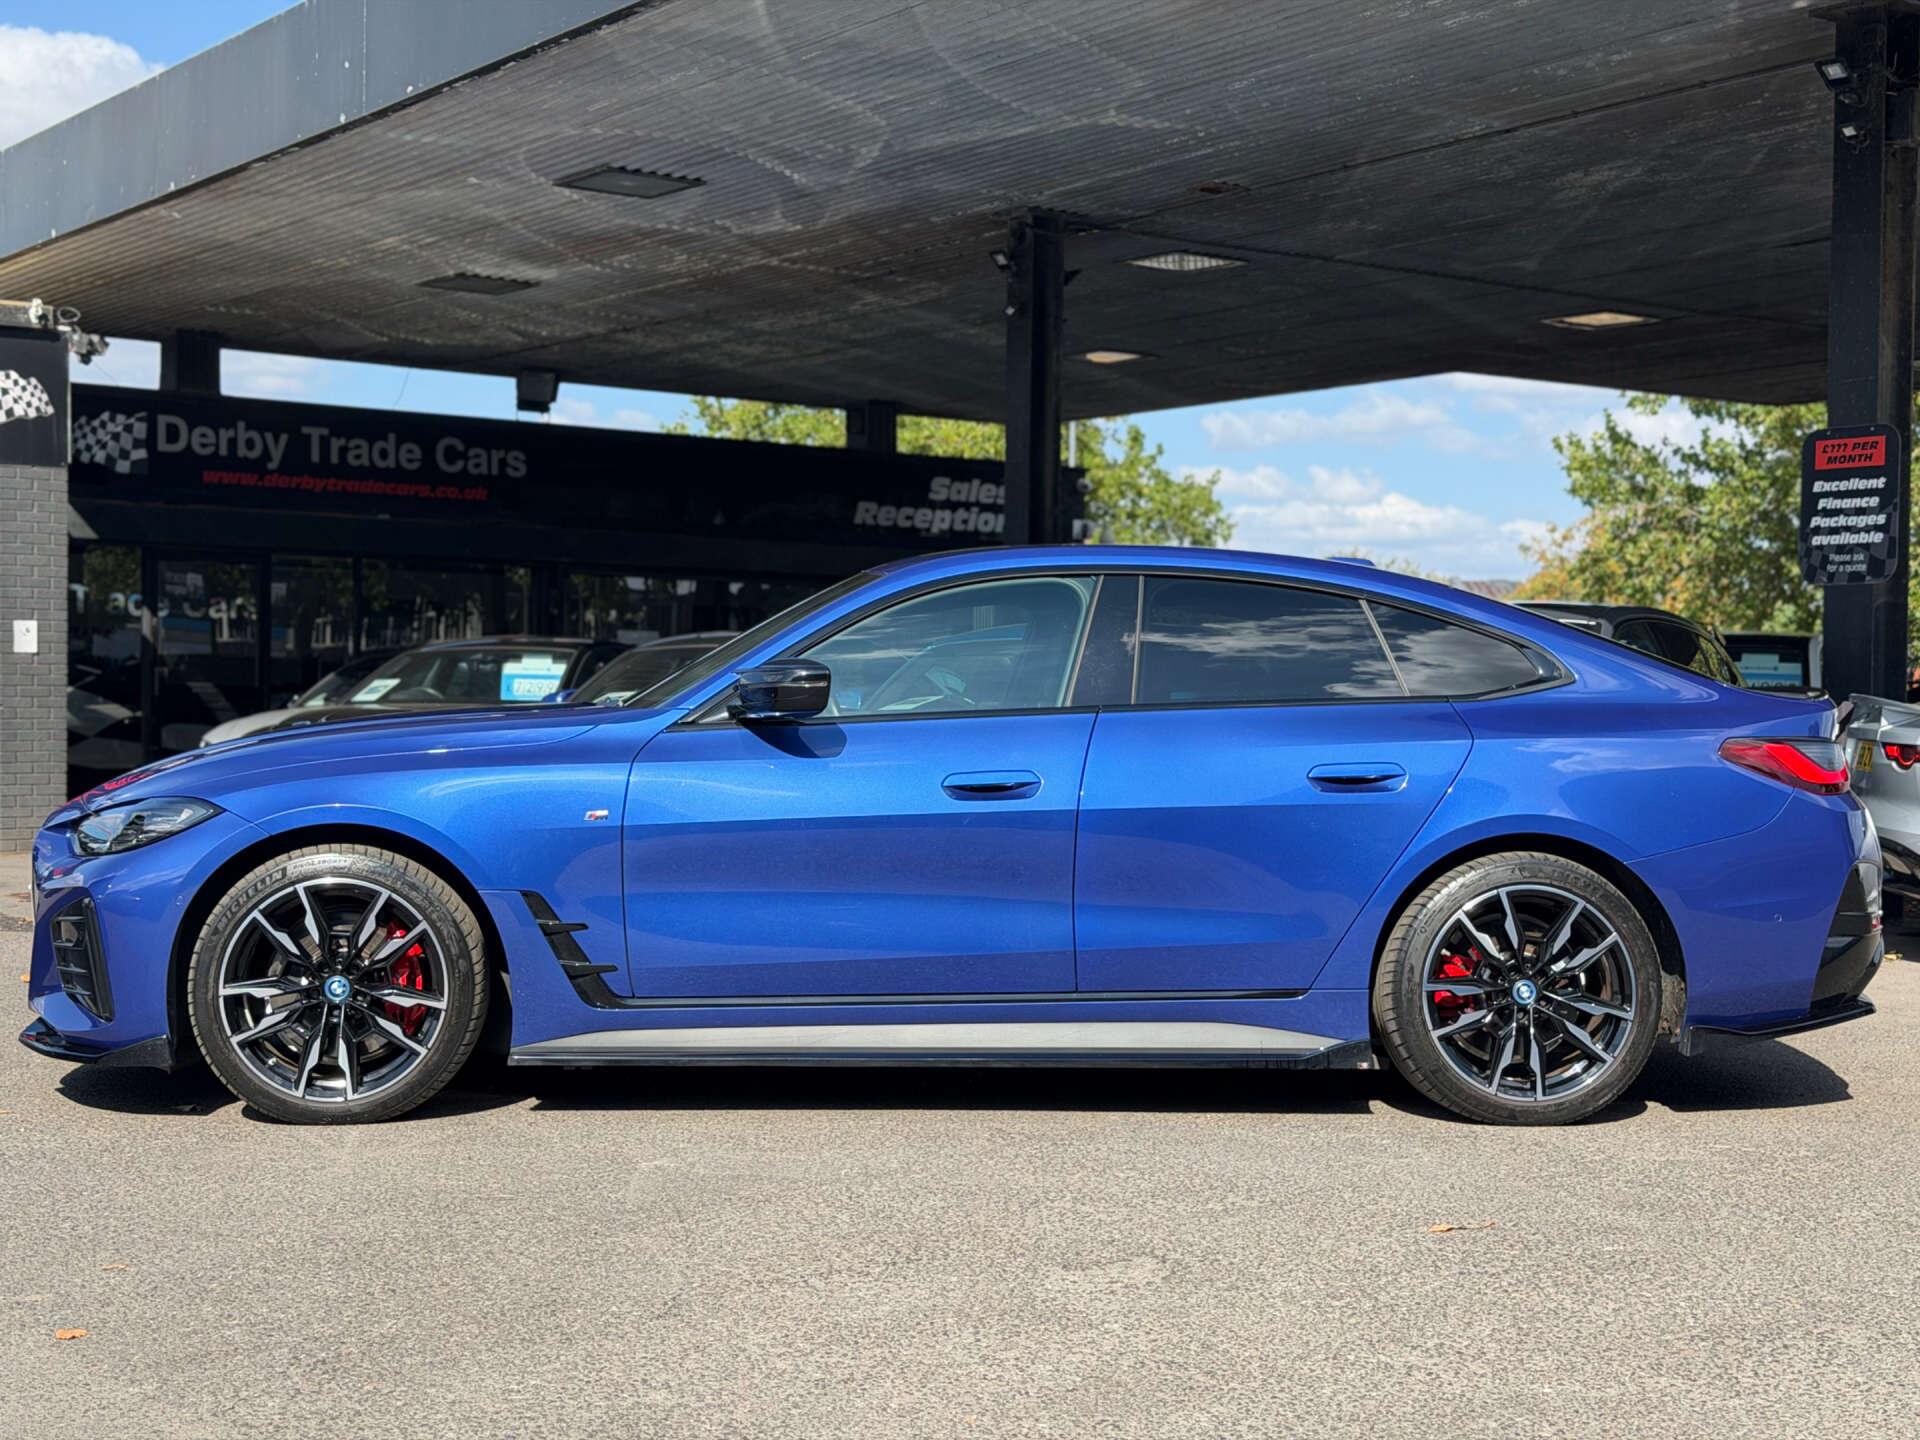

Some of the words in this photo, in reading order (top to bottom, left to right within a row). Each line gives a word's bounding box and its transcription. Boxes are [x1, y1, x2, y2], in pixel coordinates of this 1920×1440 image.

[157, 414, 289, 470] Derby
[301, 426, 422, 471] Trade
[435, 436, 527, 478] Cars
[1852, 440, 1879, 451] PER
[1827, 453, 1873, 465] MONTH
[203, 470, 488, 500] www.derbytradecars.co.uk
[1812, 477, 1887, 492] Excellent
[1818, 496, 1880, 510] Finance
[1810, 514, 1887, 529] Packages
[1812, 531, 1884, 546] available
[216, 869, 286, 930] MICHELIN
